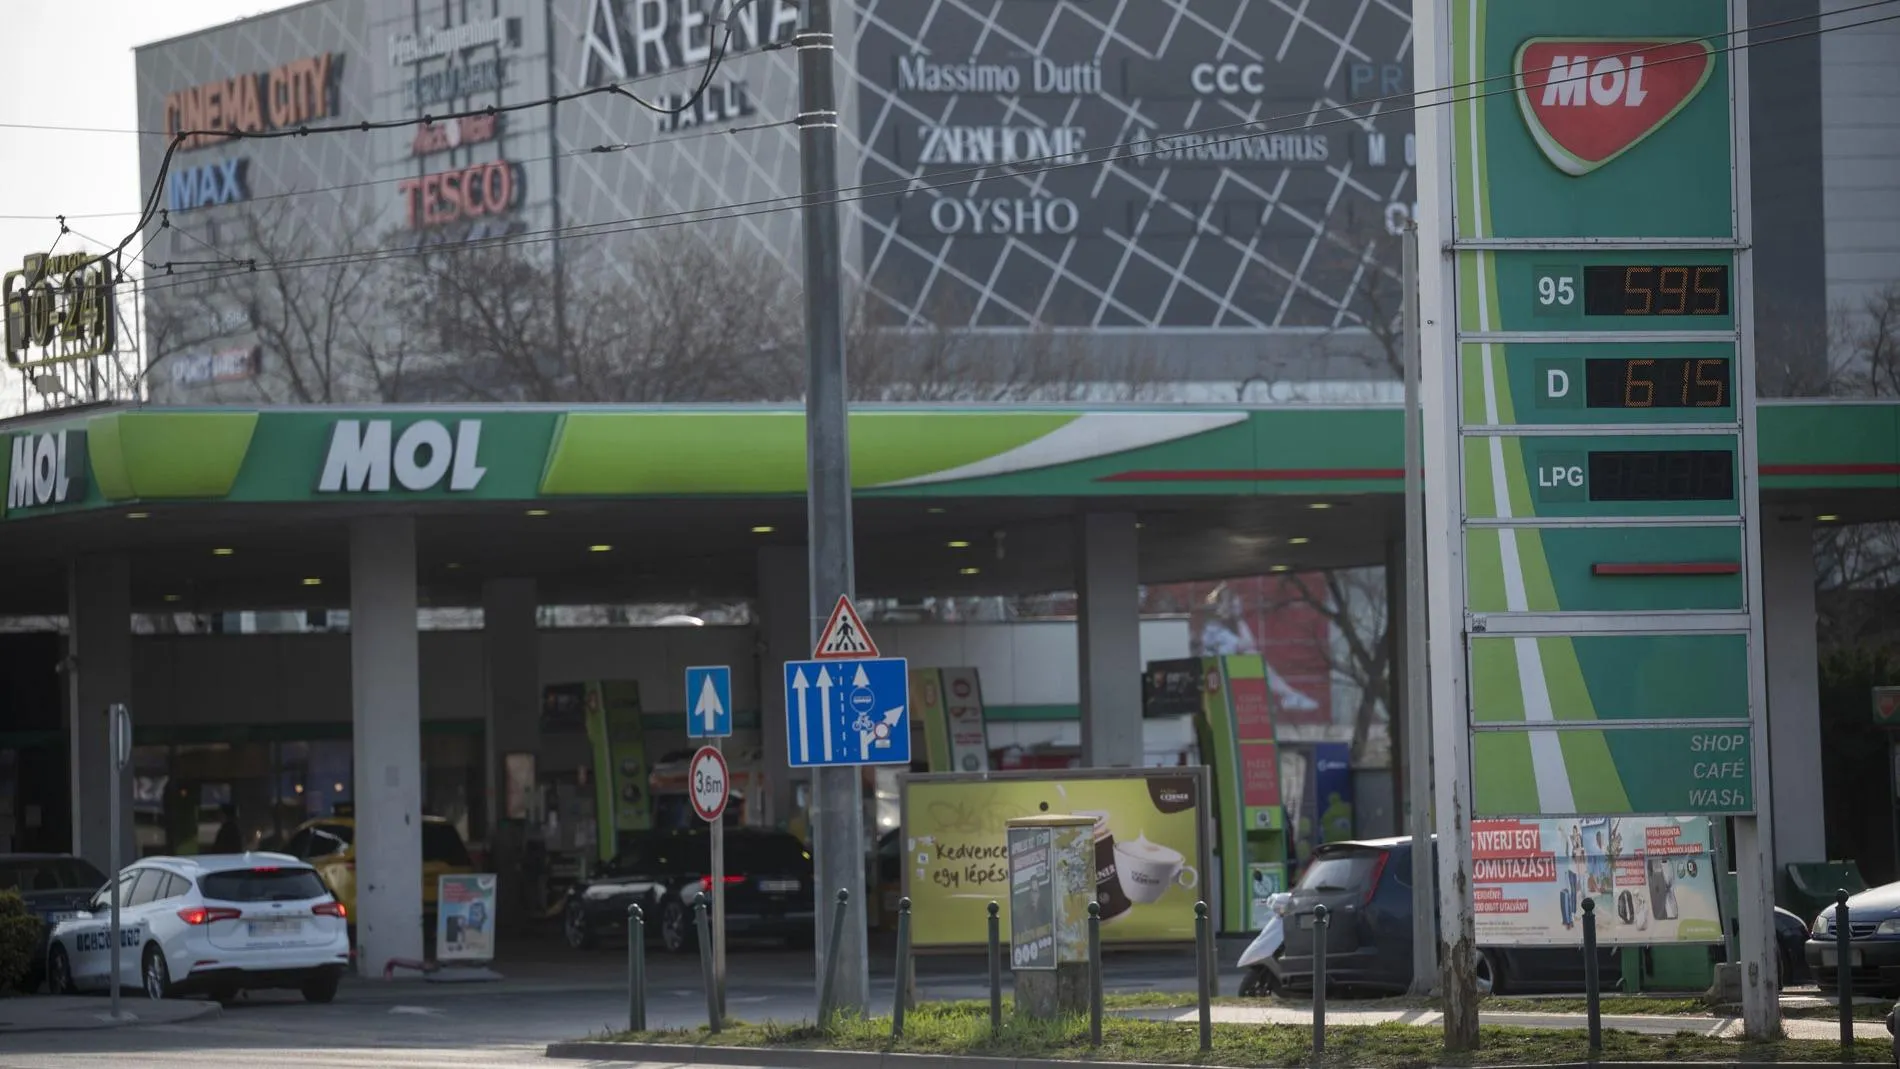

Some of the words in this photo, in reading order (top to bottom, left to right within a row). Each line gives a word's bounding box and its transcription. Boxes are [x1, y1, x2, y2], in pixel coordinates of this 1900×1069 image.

[900, 55, 1020, 92] Massimo
[1034, 57, 1101, 93] Dutti
[1191, 63, 1265, 94] CCC
[1542, 55, 1648, 107] MOL
[165, 73, 265, 152] CINEMA
[268, 52, 333, 127] CITY
[1156, 133, 1329, 161] STRADIVARIUS
[398, 159, 511, 228] TESCO
[930, 197, 1079, 234] OYSHO
[1538, 276, 1575, 305] 95
[1624, 267, 1721, 315] 595
[1547, 369, 1569, 398] D
[1624, 359, 1724, 408] 615
[8, 428, 70, 509] MOL
[319, 419, 487, 492] MOL
[1538, 466, 1584, 487] LPG
[1690, 735, 1745, 752] SHOP
[696, 770, 722, 795] 3,6m
[1693, 757, 1745, 779] CAFÉ
[936, 844, 1008, 860] Kedvence
[1477, 831, 1512, 851] NYERJ
[1515, 829, 1538, 850] EGY
[933, 870, 960, 888] egy
[1473, 853, 1556, 879] OMUTAZÁST!
